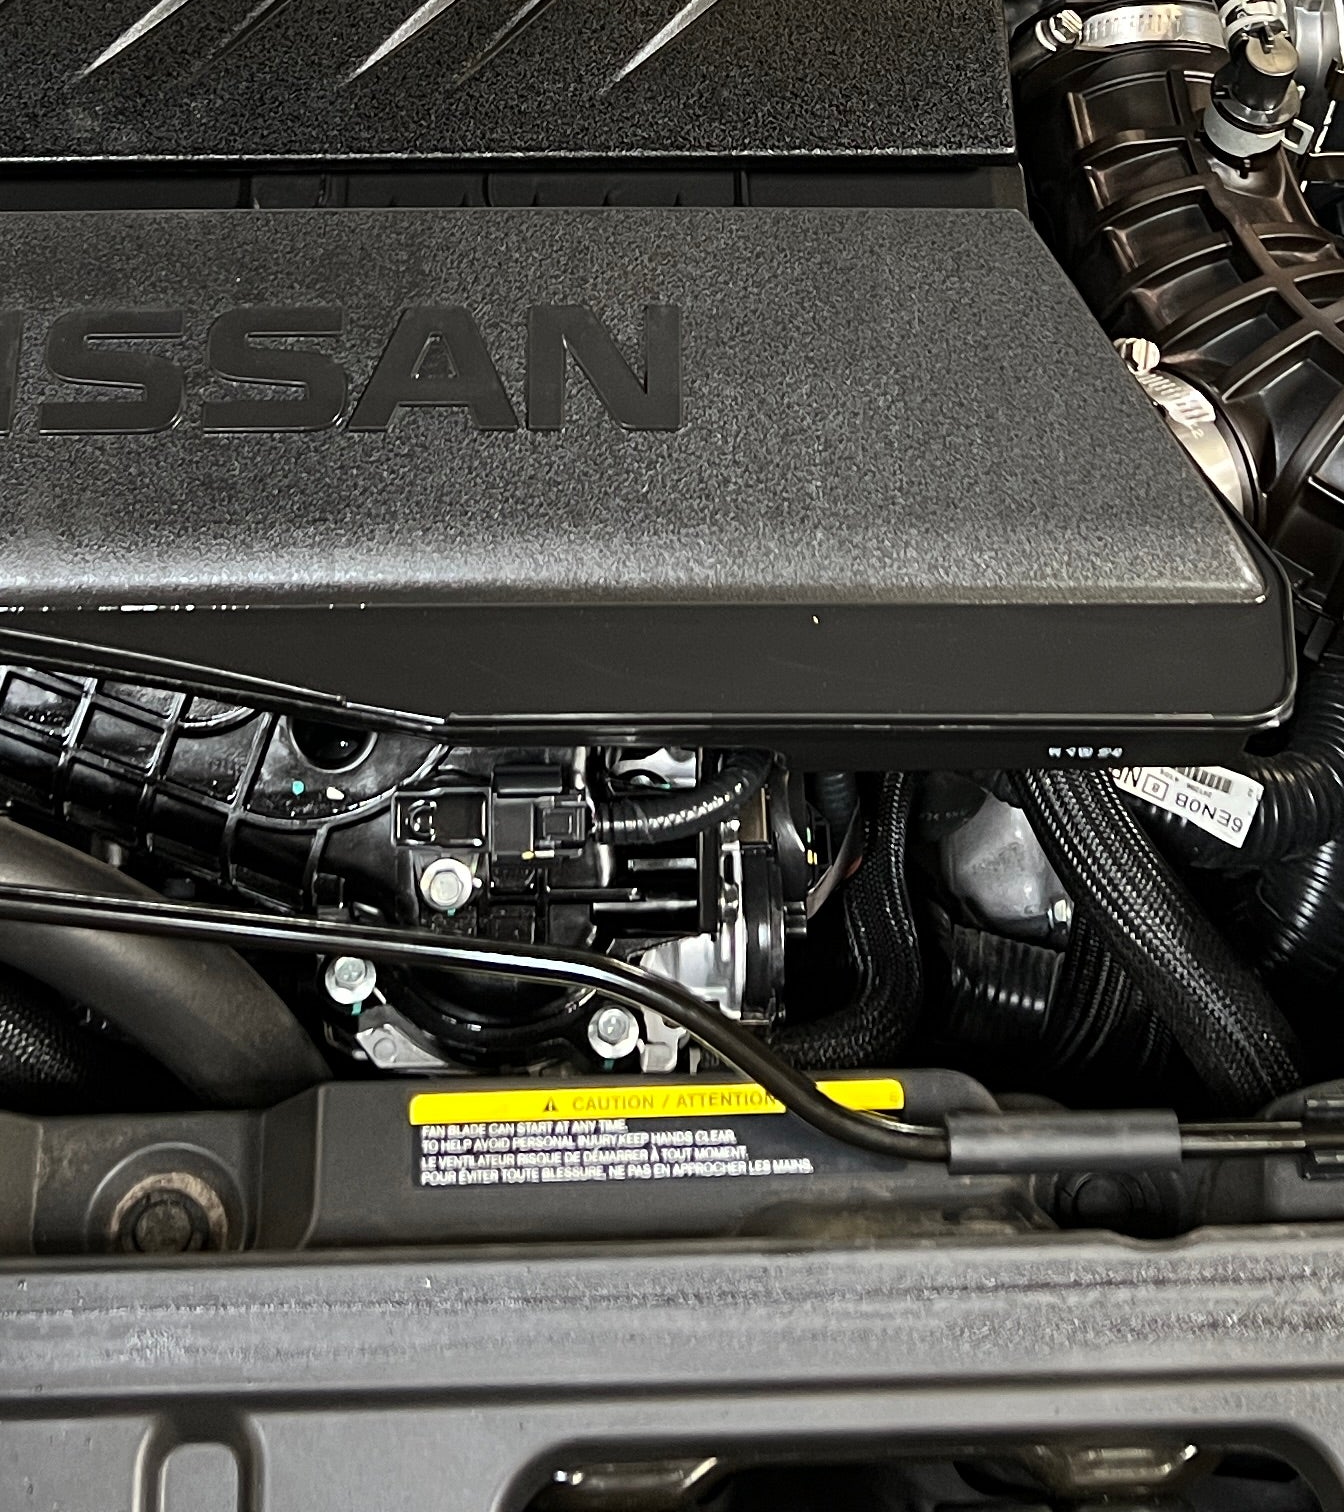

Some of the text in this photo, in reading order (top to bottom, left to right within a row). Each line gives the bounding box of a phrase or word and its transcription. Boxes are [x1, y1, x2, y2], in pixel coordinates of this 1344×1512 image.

[572, 1094, 654, 1111] CAUTION
[677, 1091, 777, 1109] ATTENTION
[421, 1125, 446, 1138] FAN
[448, 1123, 487, 1138] BLADE
[489, 1122, 515, 1136] CAN
[517, 1121, 554, 1135] START
[555, 1120, 570, 1134] AT
[571, 1119, 597, 1134] ANY
[421, 1140, 438, 1154] TO
[441, 1139, 472, 1154] HELP
[473, 1137, 510, 1153] AVOID
[512, 1135, 576, 1151] PERSONAL
[650, 1130, 693, 1146] HANDS
[421, 1156, 437, 1170] LE
[438, 1153, 515, 1169] VENTILATEUR
[517, 1151, 562, 1167] RISQUE
[564, 1150, 581, 1166] DE
[582, 1148, 648, 1165] DÉMARRER
[661, 1146, 692, 1161] TOUT
[421, 1171, 457, 1186] POUR
[458, 1167, 499, 1185] ÉVITER
[500, 1168, 539, 1184] TOUTE
[608, 1165, 626, 1181] NE
[628, 1163, 652, 1179] PAS
[653, 1163, 671, 1178] EN
[672, 1160, 747, 1178] APPROCHER
[748, 1158, 772, 1176] LES
